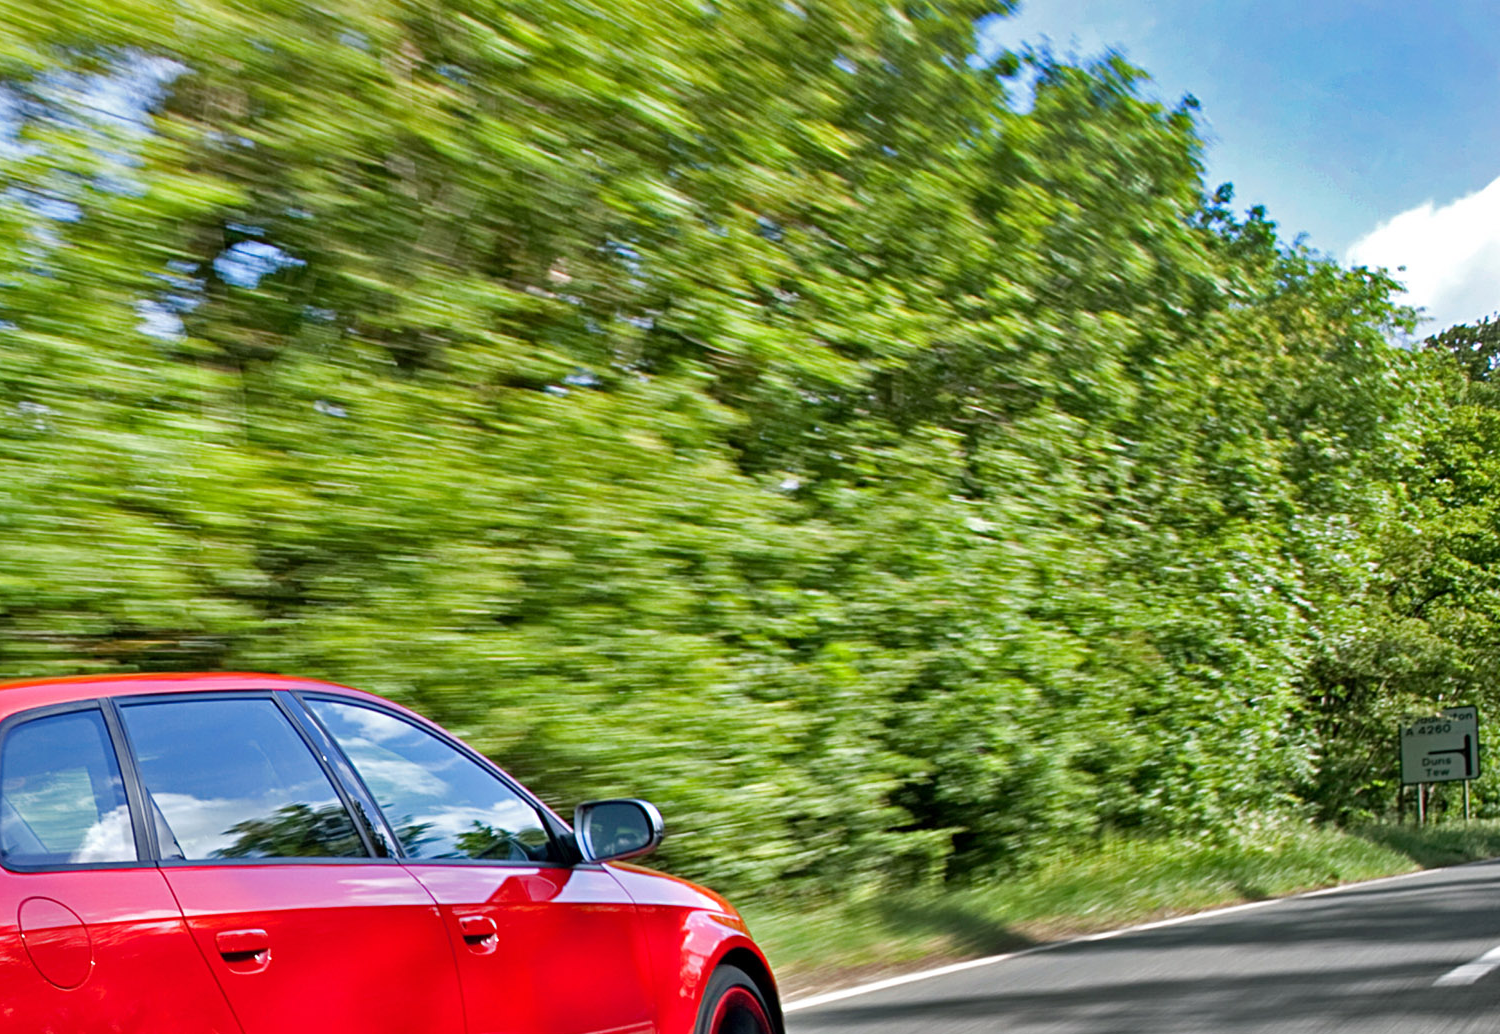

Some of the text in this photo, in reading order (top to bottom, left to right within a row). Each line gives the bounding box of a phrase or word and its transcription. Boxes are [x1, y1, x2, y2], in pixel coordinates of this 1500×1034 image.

[1405, 724, 1451, 737] A 4260
[1422, 758, 1451, 767] Duns
[1425, 768, 1450, 777] Tew
